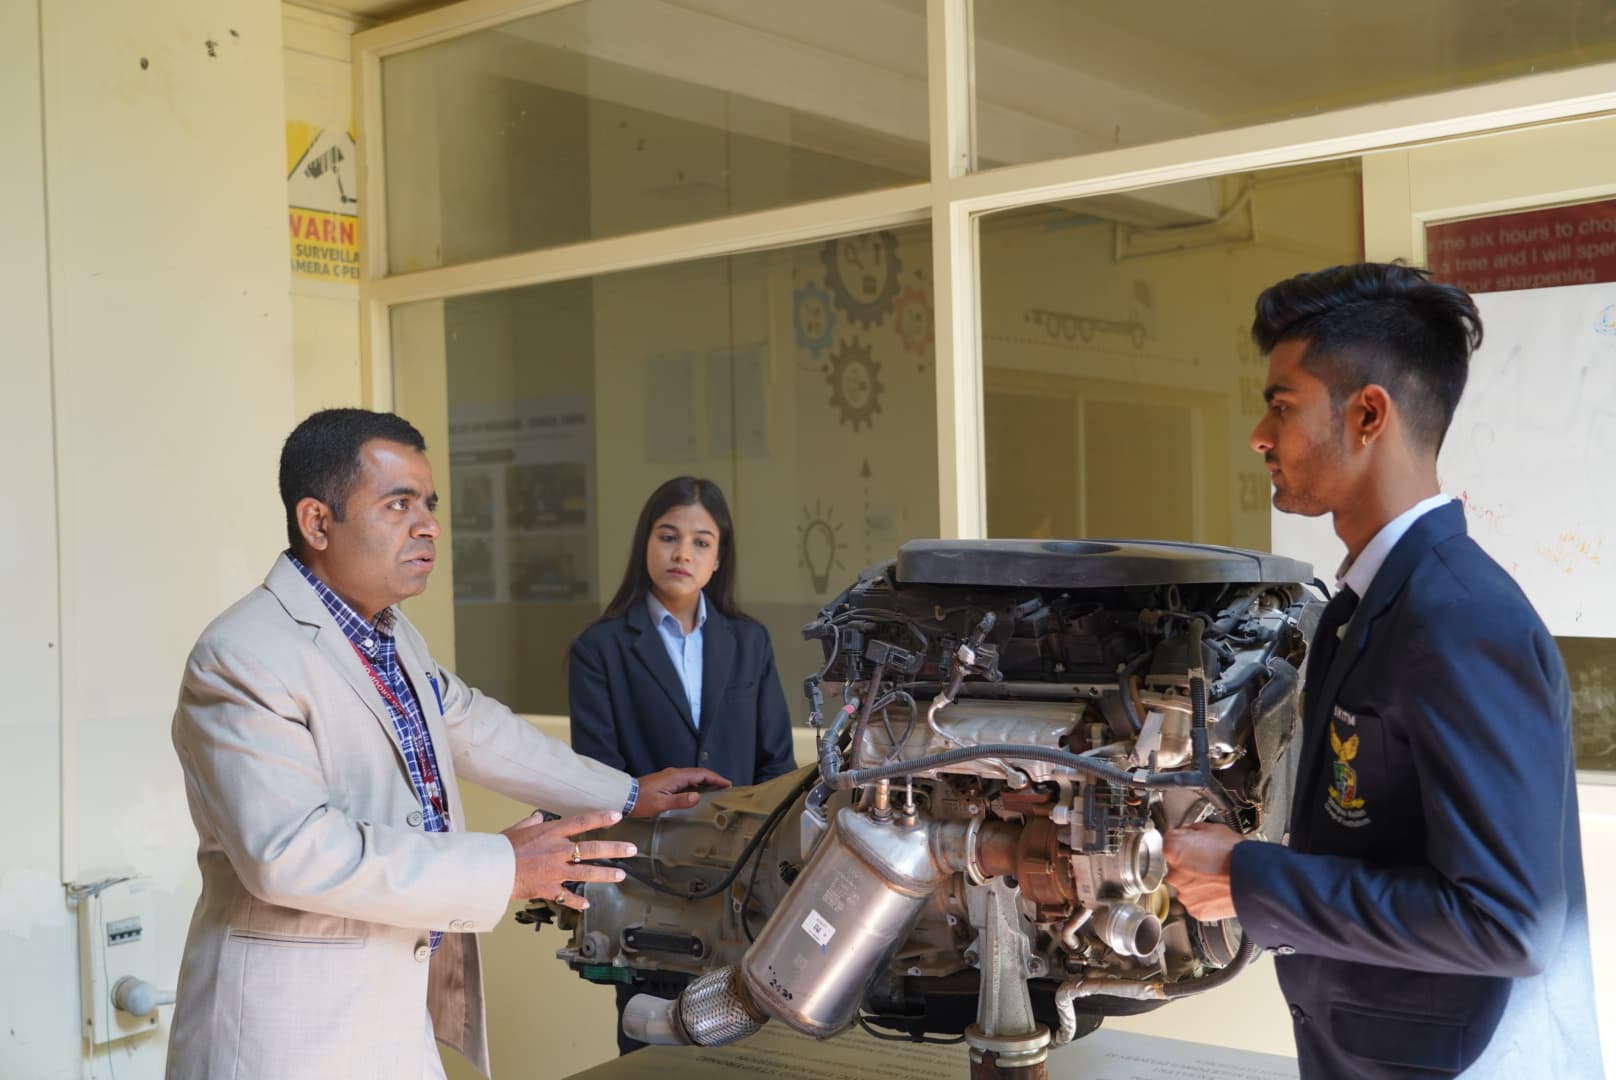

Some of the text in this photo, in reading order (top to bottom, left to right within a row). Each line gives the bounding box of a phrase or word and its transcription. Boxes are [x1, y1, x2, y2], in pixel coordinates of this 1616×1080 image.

[1471, 233, 1494, 247] six
[1500, 226, 1549, 244] hours
[1555, 222, 1573, 237] to
[1578, 217, 1616, 234] cho
[1455, 257, 1488, 272] tree
[1493, 251, 1527, 268] and
[1542, 244, 1571, 261] will
[1495, 268, 1596, 290] sharpening
